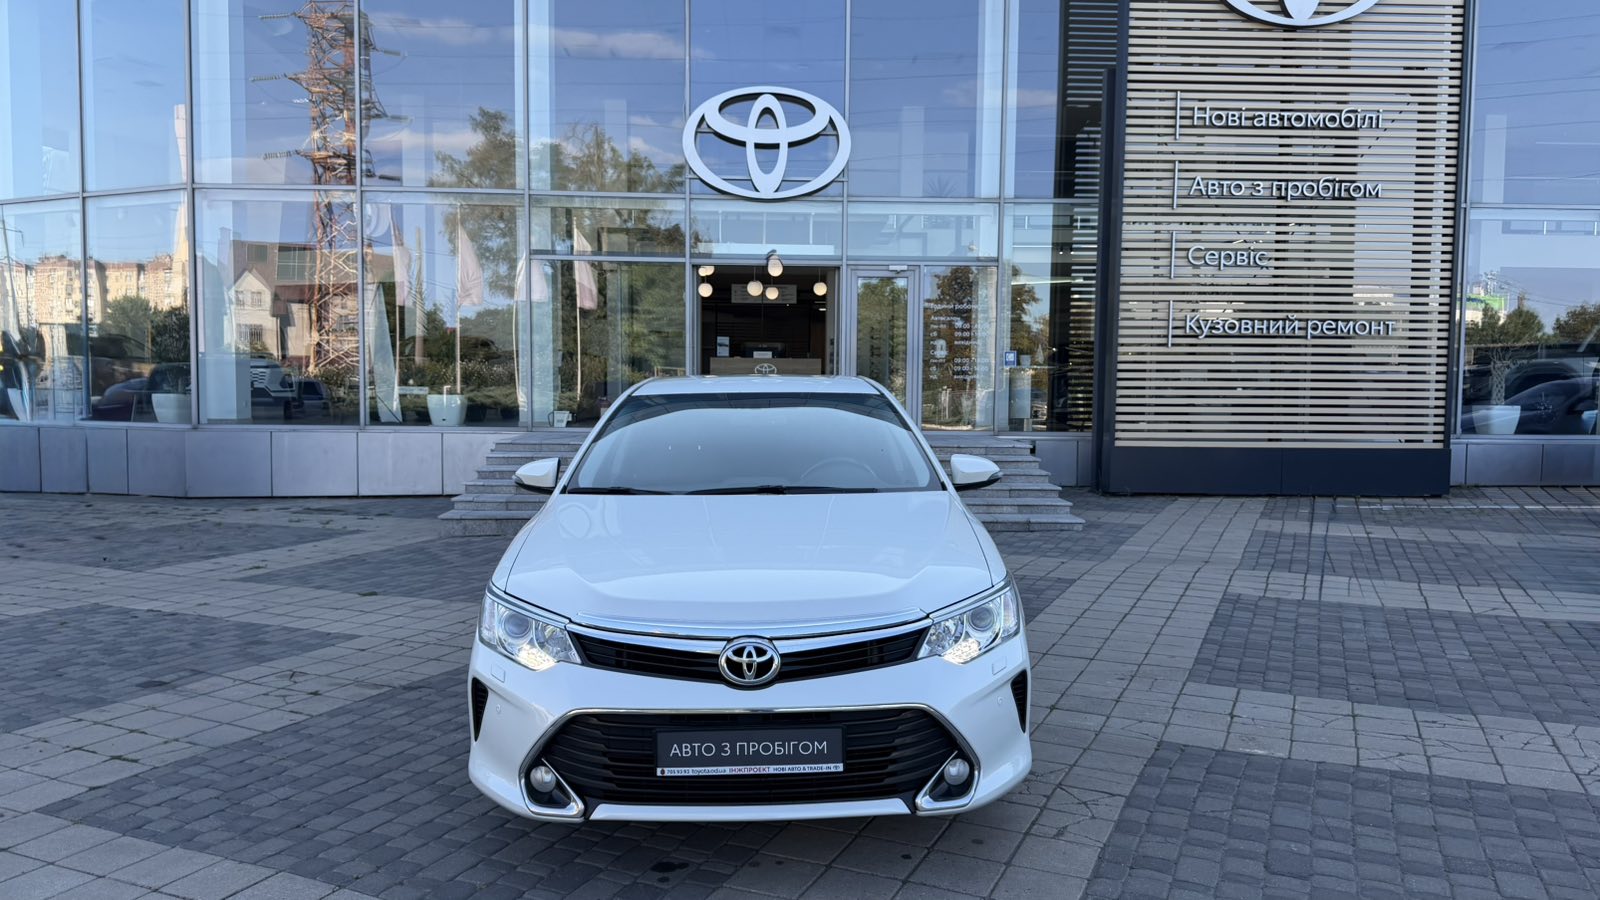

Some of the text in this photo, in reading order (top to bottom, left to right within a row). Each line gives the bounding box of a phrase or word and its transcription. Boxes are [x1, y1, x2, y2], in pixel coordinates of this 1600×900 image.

[1192, 106, 1384, 129] Нові автомобілі
[1189, 176, 1382, 202] Авто з пробігом
[1187, 246, 1270, 270] Сервіс
[1185, 314, 1397, 340] Кузовний ремонт
[670, 741, 828, 757] АВТО З ПРОБІГОМ
[728, 766, 771, 774] ІНЖПРОЕКТ
